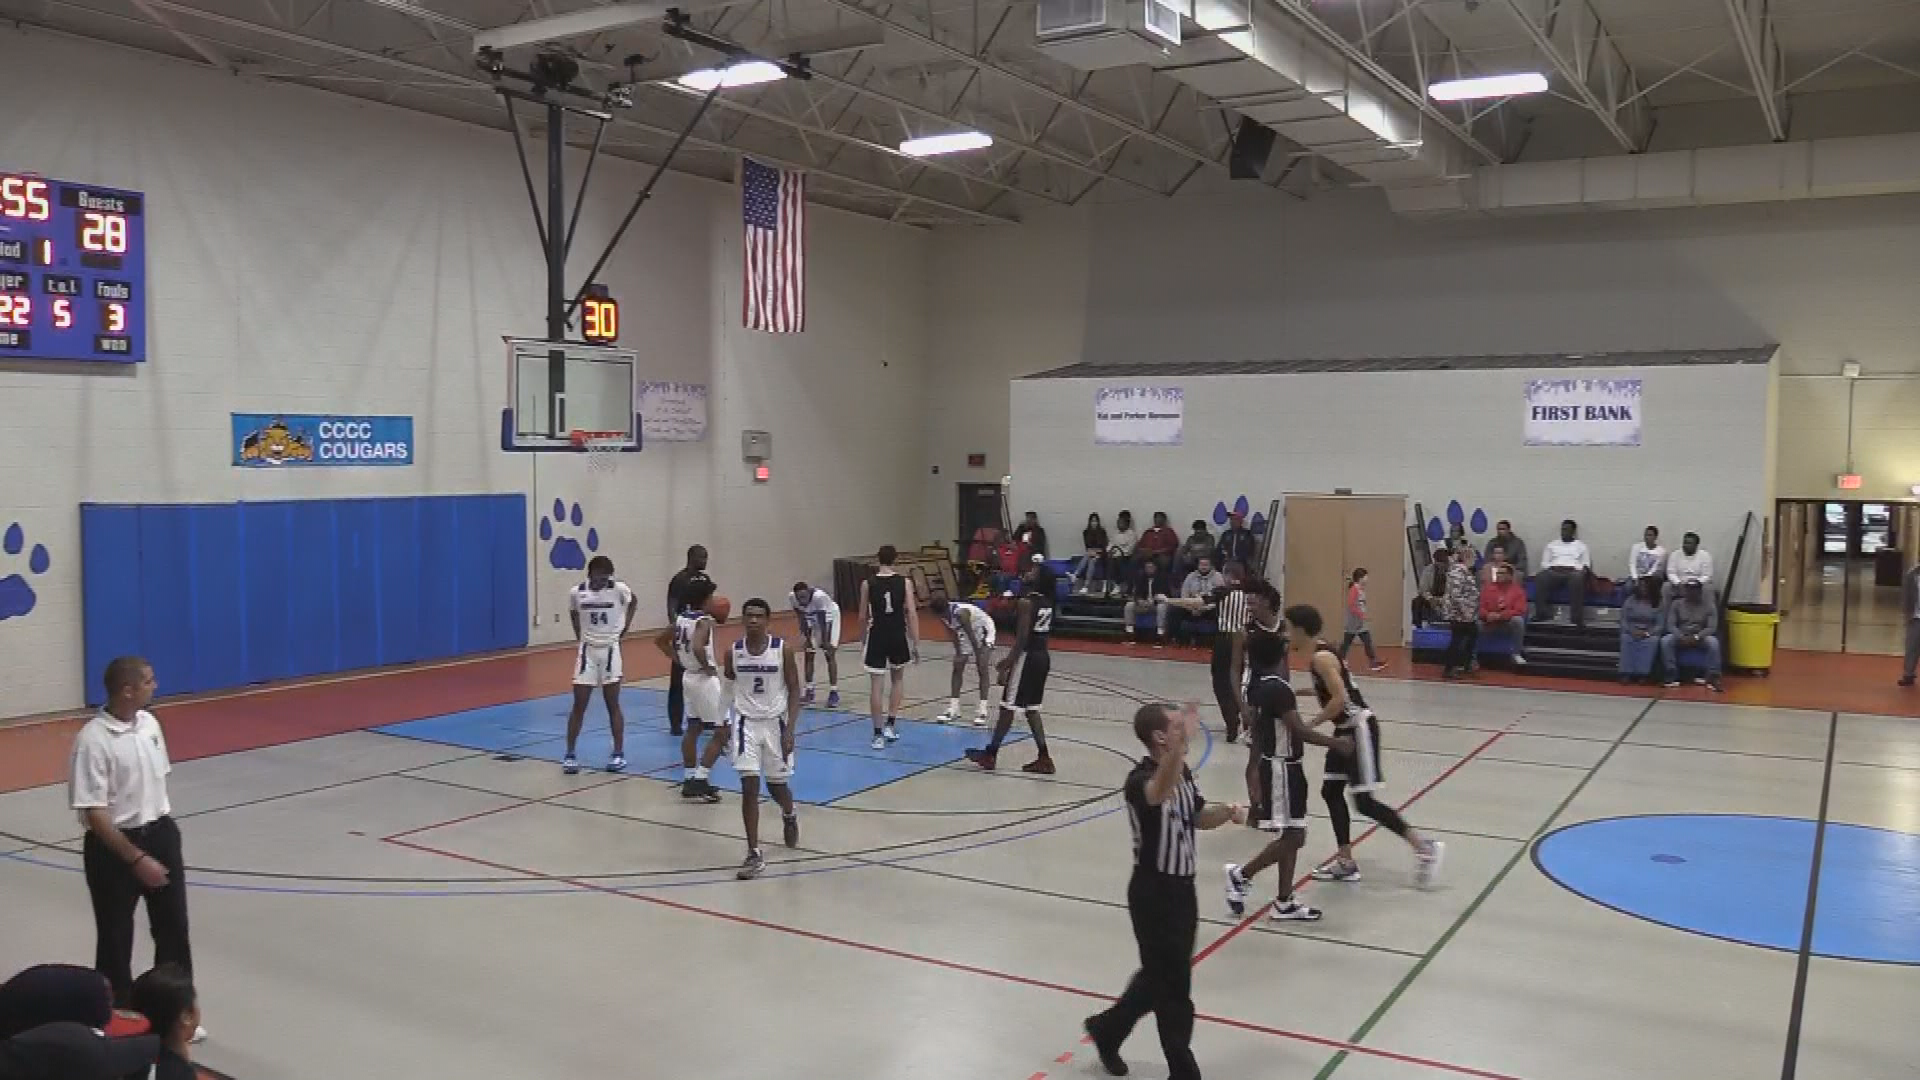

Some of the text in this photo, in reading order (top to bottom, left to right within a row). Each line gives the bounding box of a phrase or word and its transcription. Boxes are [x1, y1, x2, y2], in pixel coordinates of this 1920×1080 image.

[79, 191, 124, 213] Guests
[83, 213, 126, 253] 28
[44, 239, 51, 265] 1
[97, 281, 129, 298] Fouls
[53, 299, 71, 327] 5
[108, 303, 124, 331] 3
[585, 301, 616, 336] 30
[1532, 405, 1633, 421] FIRST BANK
[319, 422, 372, 439] CCCC
[319, 442, 408, 459] COUGARS
[884, 591, 894, 613] 1
[753, 677, 765, 694] 2
